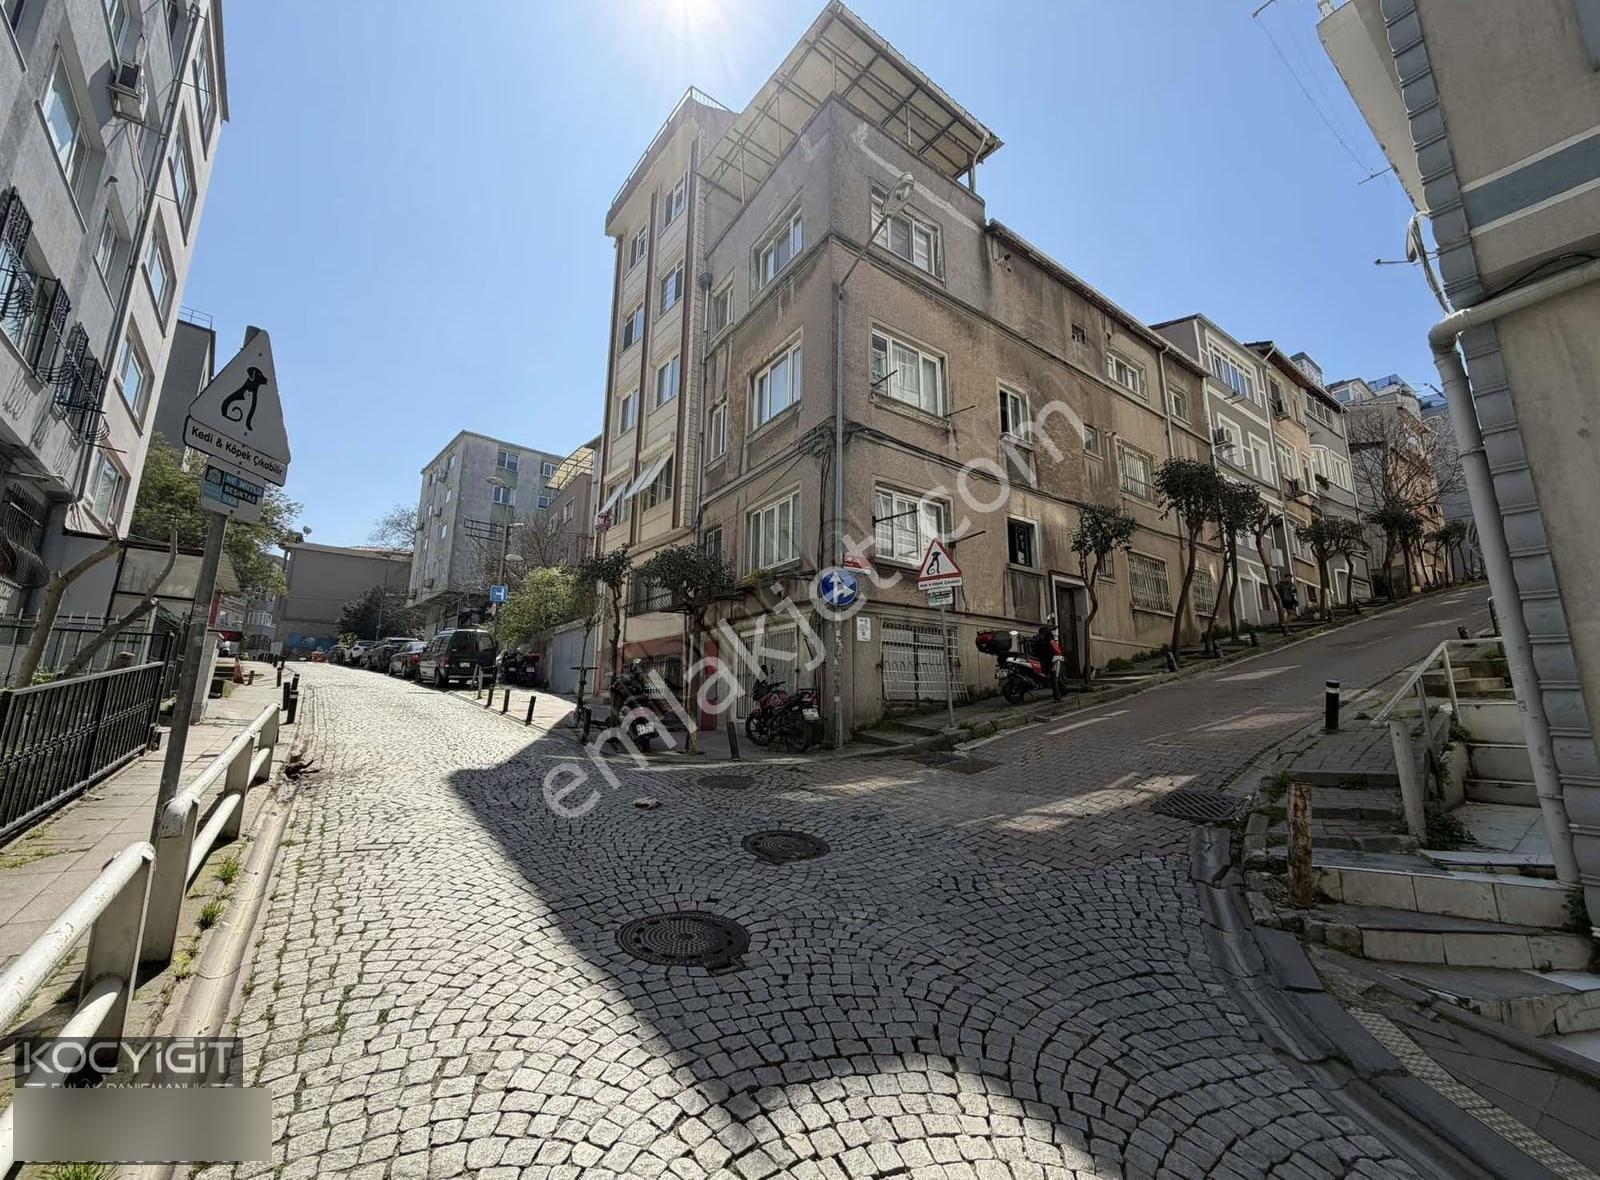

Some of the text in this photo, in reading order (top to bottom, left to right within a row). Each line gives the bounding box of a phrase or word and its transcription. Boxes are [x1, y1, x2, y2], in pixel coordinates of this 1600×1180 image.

[191, 425, 213, 444] Kedi
[215, 437, 223, 449] &
[225, 441, 252, 461] Köpek
